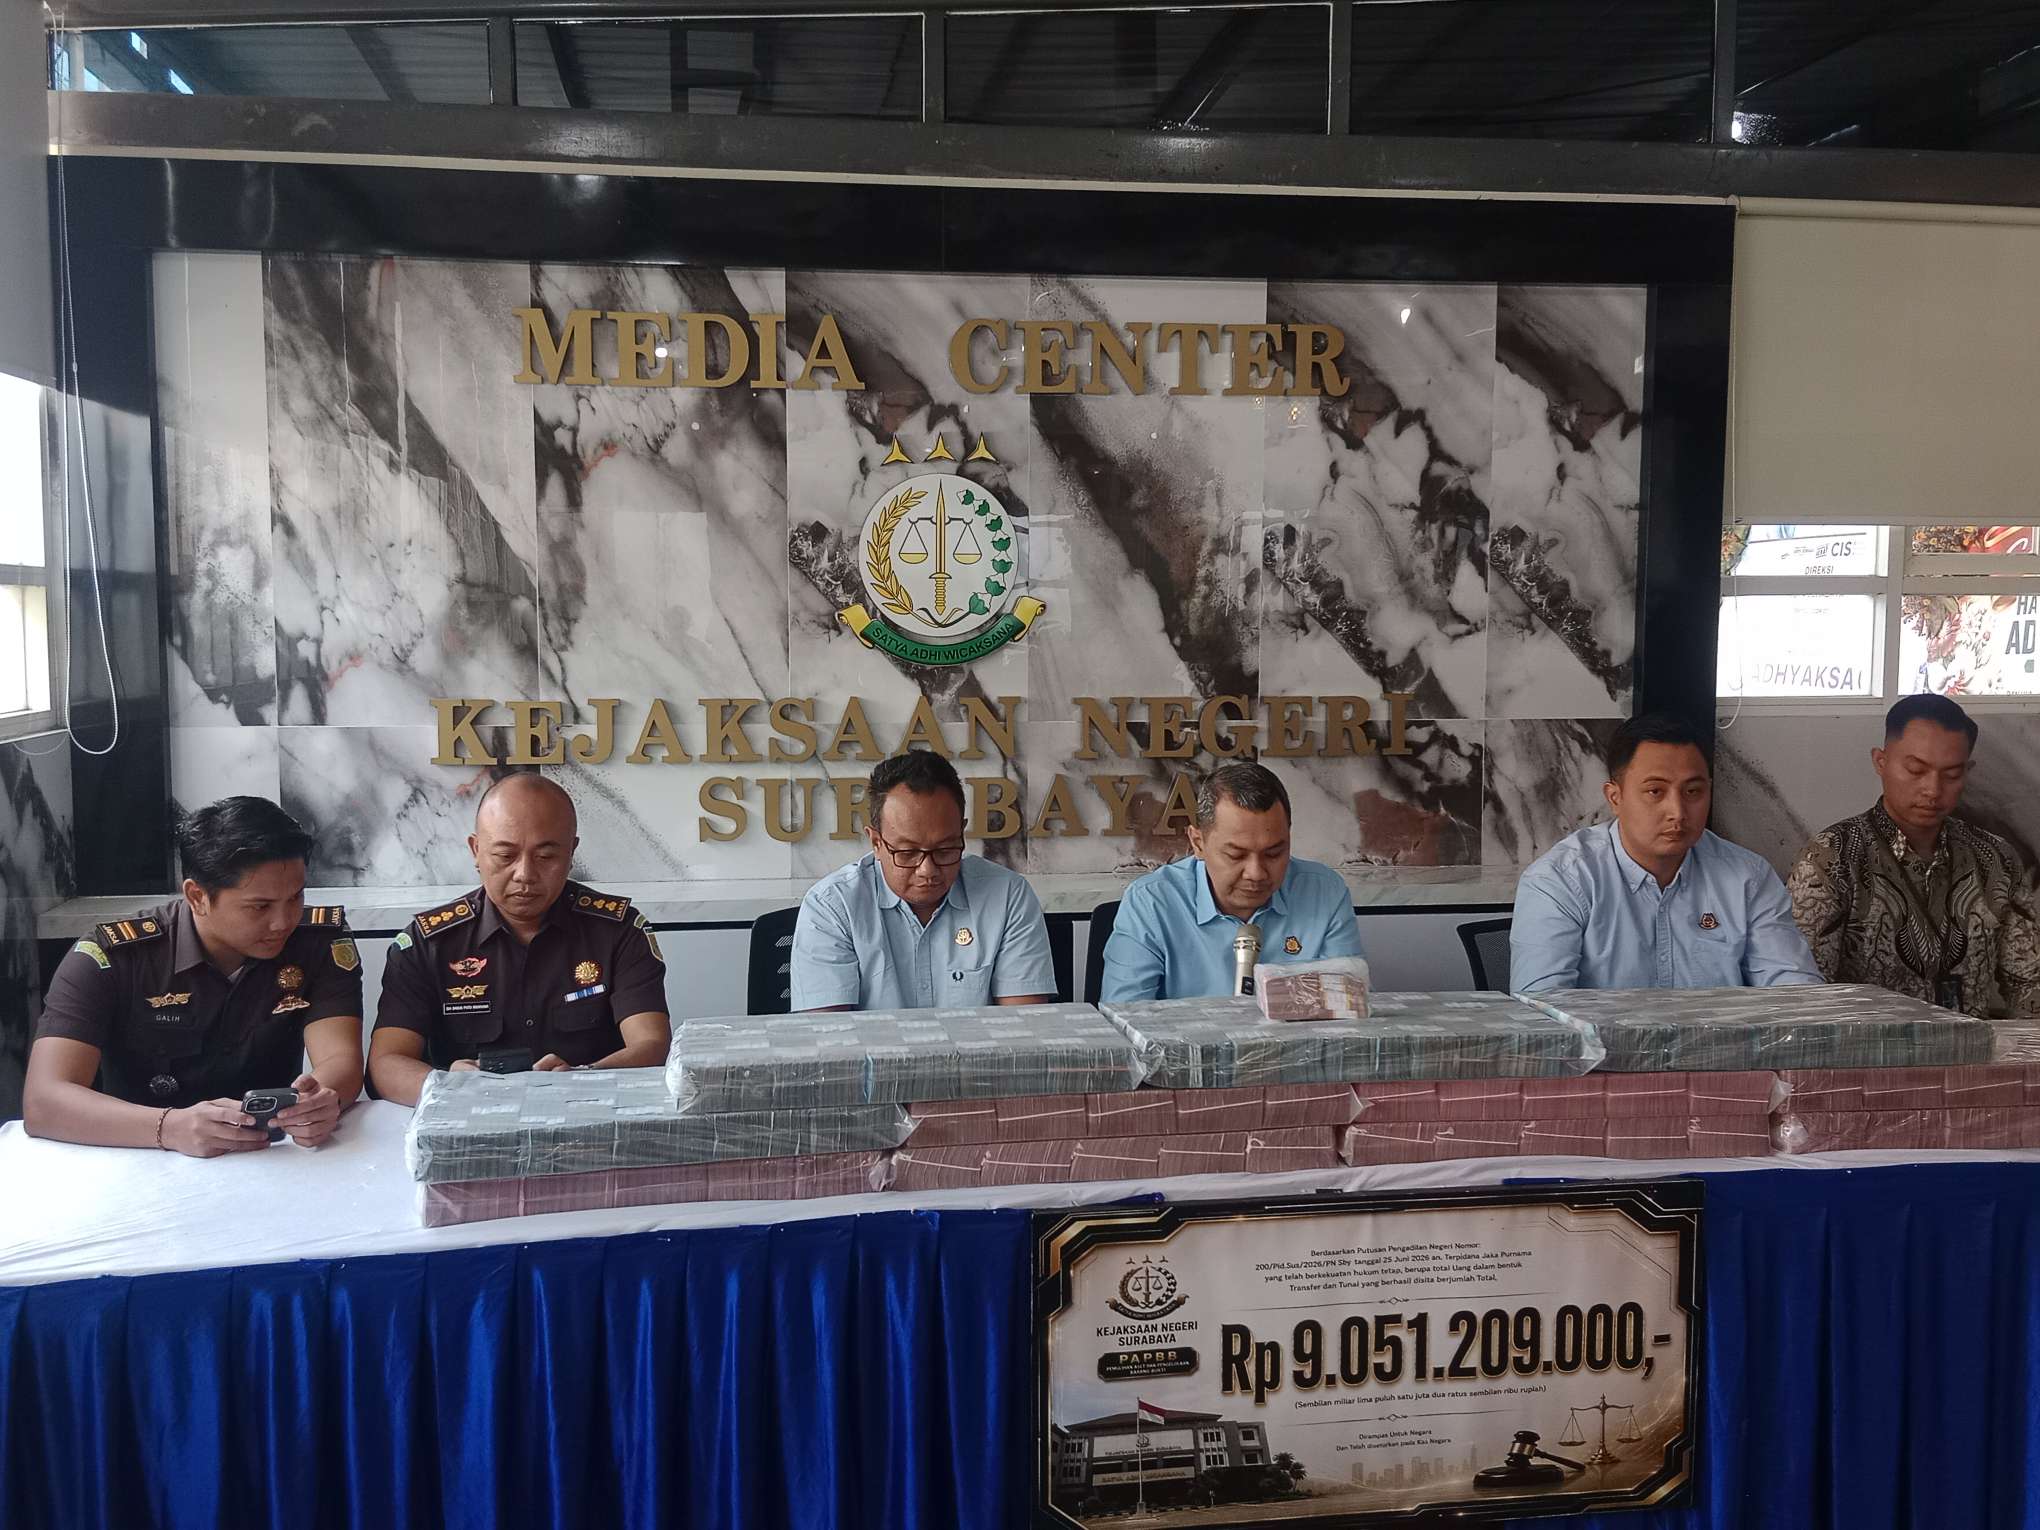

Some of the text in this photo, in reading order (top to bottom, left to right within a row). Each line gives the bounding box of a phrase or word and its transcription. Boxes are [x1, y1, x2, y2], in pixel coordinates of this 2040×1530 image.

[512, 307, 1351, 397] MEDIA CENTER
[1804, 566, 1834, 575] DIREKSI
[873, 622, 1014, 661] SATYA ADHI WICAKSANA
[431, 693, 1416, 766] KEJAKSAAN NEGERI
[699, 773, 1200, 843] SURBAYA
[101, 924, 120, 945] JAKSA
[155, 1014, 180, 1022] GALIH
[1310, 1242, 1480, 1257] Berdasarkan Putusan Pengadilan Negeri Nomor:
[1338, 1259, 1351, 1268] Sby
[1354, 1257, 1381, 1266] tanggal
[1383, 1256, 1392, 1264] 25
[1394, 1255, 1410, 1263] Juni
[1411, 1254, 1429, 1262] 2026
[1445, 1252, 1480, 1261] Terpidana
[1481, 1251, 1498, 1259] Jaka
[1500, 1250, 1532, 1258] Purnama
[1265, 1275, 1283, 1283] yang
[1284, 1273, 1303, 1281] telah
[1305, 1270, 1351, 1280] berkekuatan
[1353, 1269, 1379, 1277] hukum
[1404, 1265, 1430, 1274] berupa
[1432, 1264, 1450, 1272] total
[1452, 1264, 1471, 1273] Uang
[1473, 1262, 1495, 1271] dalam
[1497, 1261, 1522, 1270] bentuk
[1290, 1283, 1321, 1292] Transfer
[1322, 1281, 1337, 1290] dan
[1339, 1280, 1359, 1288] Tunai
[1361, 1280, 1379, 1289] yang
[1381, 1277, 1411, 1286] berhasil
[1413, 1276, 1434, 1284] disita
[1436, 1274, 1475, 1284] berjumlah
[1096, 1320, 1198, 1337] KEJAKSAAN NEGERI
[1118, 1333, 1177, 1347] SURABAYA
[1221, 1300, 1672, 1406] Rp 9.051.209.000,-
[1295, 1399, 1332, 1409] (Sembilan
[1334, 1397, 1356, 1405] miliar
[1357, 1396, 1374, 1404] lima
[1374, 1394, 1396, 1403] puluh
[1397, 1393, 1413, 1401] satu
[1414, 1391, 1430, 1400] juta
[1431, 1391, 1446, 1399] dua
[1447, 1390, 1468, 1398] ratus
[1469, 1388, 1502, 1397] sembilan
[1520, 1385, 1547, 1394] rupiah)
[1359, 1428, 1432, 1441] Dirampas Untuk Negara
[1430, 1437, 1452, 1446] Negara
